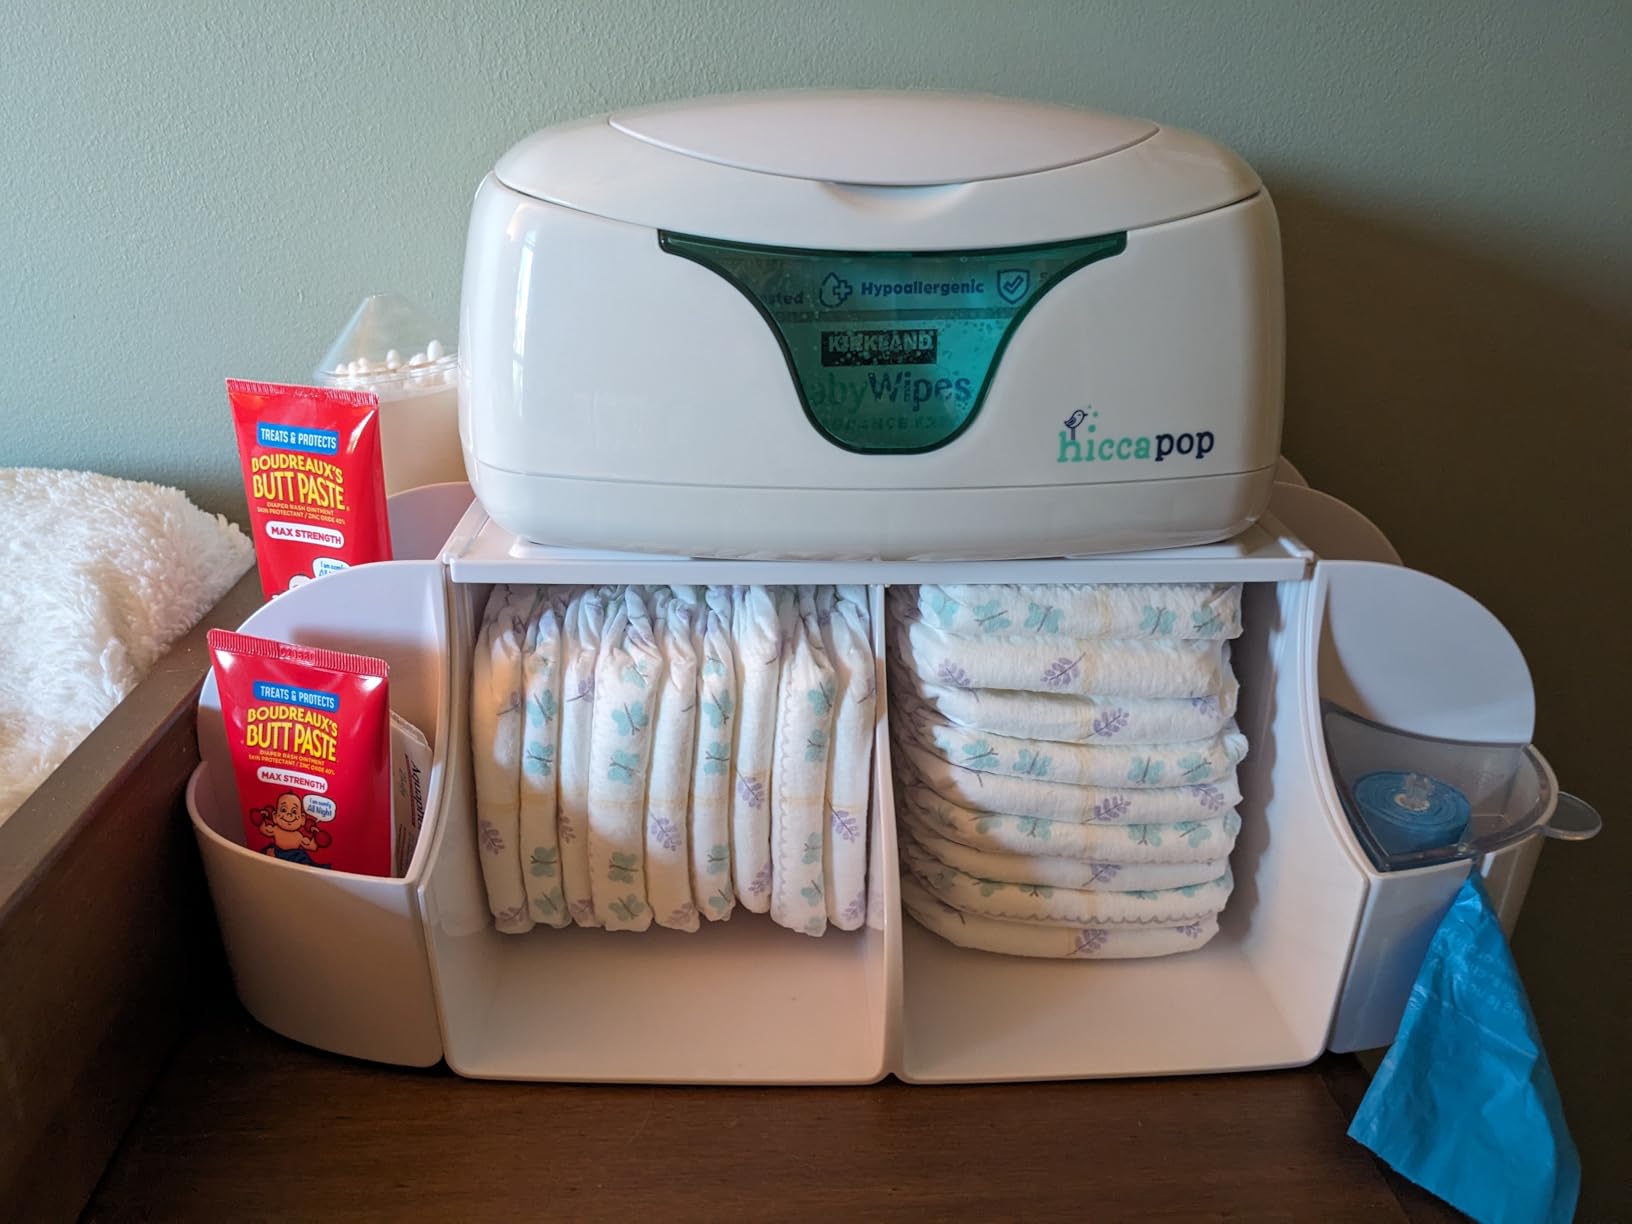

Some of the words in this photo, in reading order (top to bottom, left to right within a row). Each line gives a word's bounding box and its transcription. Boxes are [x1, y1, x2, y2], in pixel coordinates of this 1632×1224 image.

[860, 279, 985, 298] Hypoallergenic
[828, 332, 933, 353] KIRKLAND
[261, 427, 289, 444] TREATS
[290, 432, 296, 444] &
[298, 432, 337, 450] PROTECTS
[1057, 424, 1215, 463] hiccapop
[251, 453, 344, 484] BOUDREAUX'S
[252, 471, 295, 502] BUTT
[297, 473, 346, 511] PASTE
[267, 501, 289, 509] DIAPER
[269, 507, 304, 518] PROTECTANT
[271, 526, 294, 537] MAX
[295, 529, 342, 545] STRENGTH
[260, 685, 289, 701] TREATS
[291, 690, 297, 701] &
[298, 691, 335, 709] PROTECTS
[247, 706, 338, 738] BOUDREAUX'S
[246, 722, 292, 752] BUTT
[294, 724, 337, 763] PASTE
[260, 749, 281, 757] DIAPER
[282, 752, 298, 760] RASH
[298, 755, 325, 766] OINTMENT
[261, 755, 295, 766] PROTECTANT
[261, 771, 282, 781] MAX
[283, 775, 326, 791] STRENGTH
[307, 804, 315, 813] All
[315, 805, 332, 817] Night
